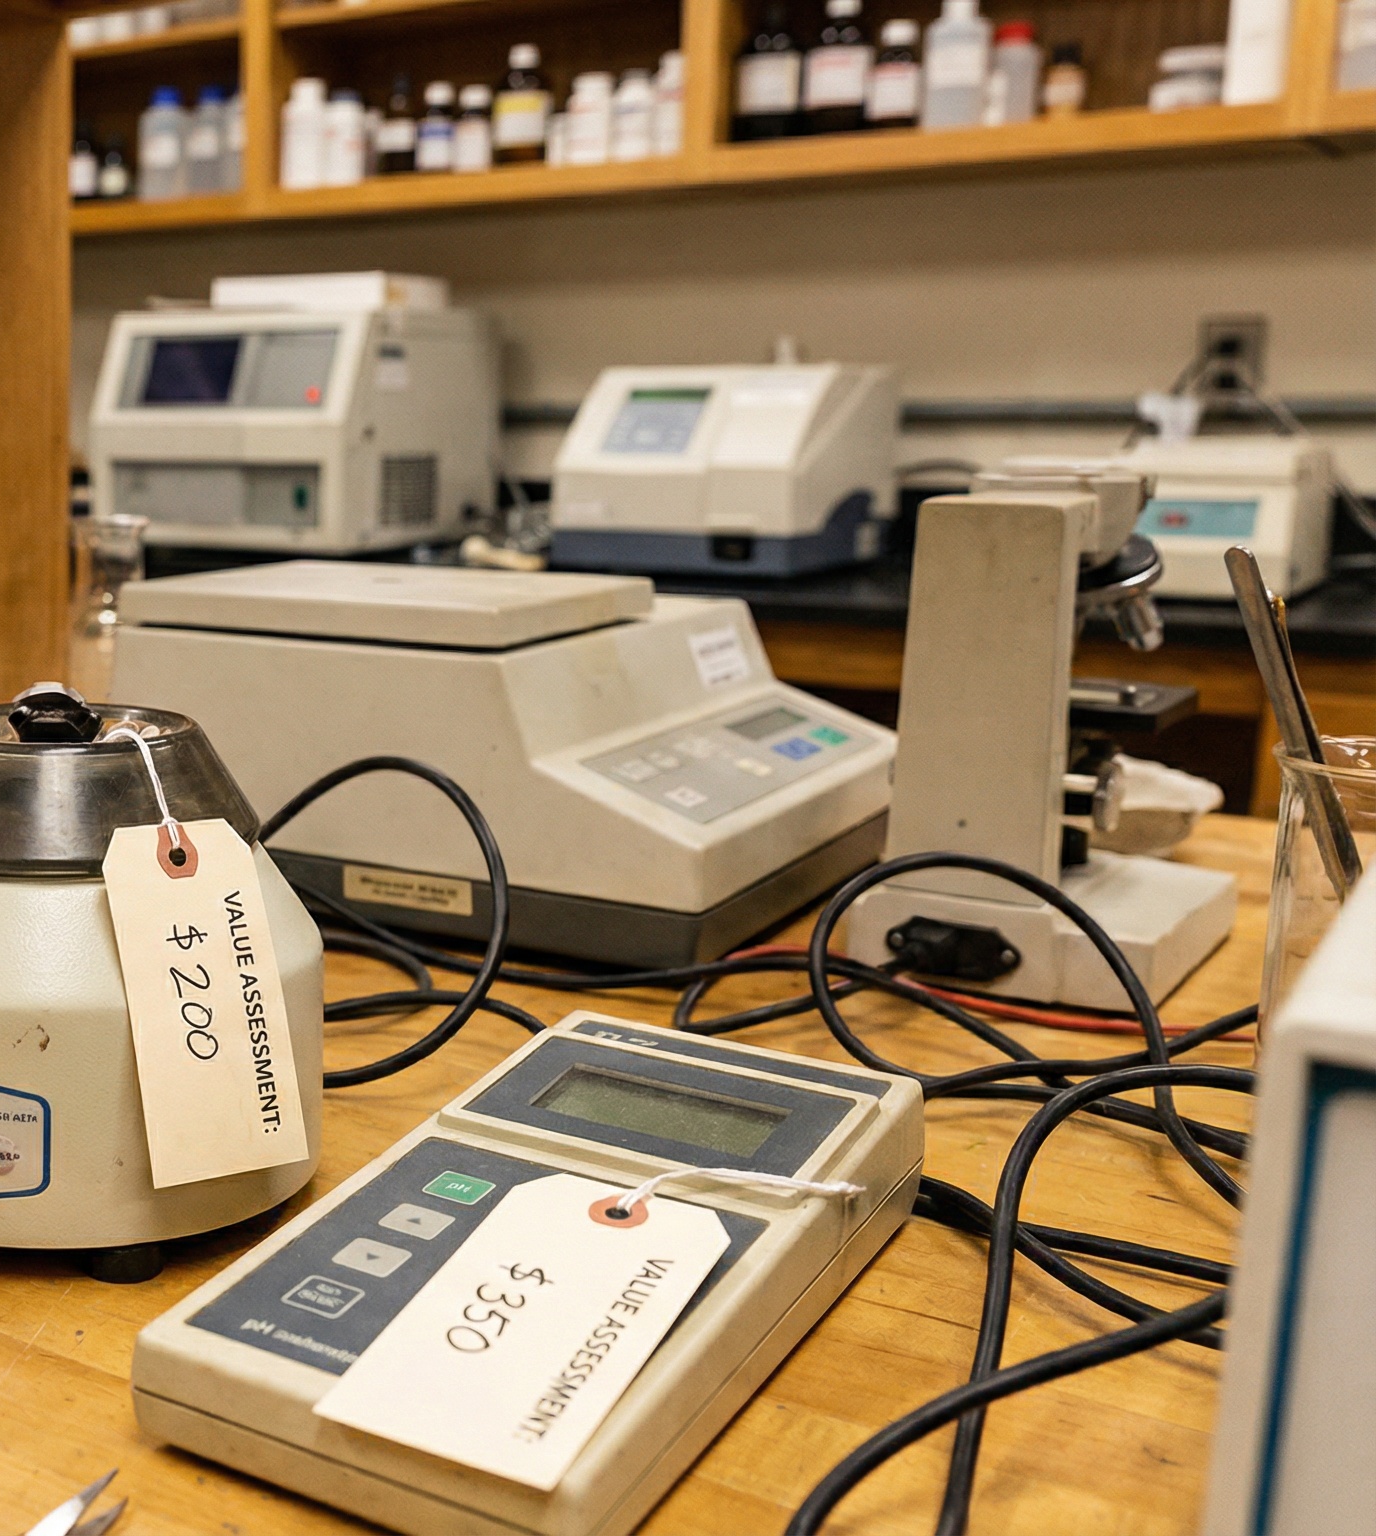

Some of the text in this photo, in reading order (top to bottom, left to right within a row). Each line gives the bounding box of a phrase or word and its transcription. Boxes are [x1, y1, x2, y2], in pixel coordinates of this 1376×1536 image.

[224, 890, 282, 1134] VALUE ASSESSMENT:
[512, 1258, 675, 1444] VALUE ASSESSMENT:
